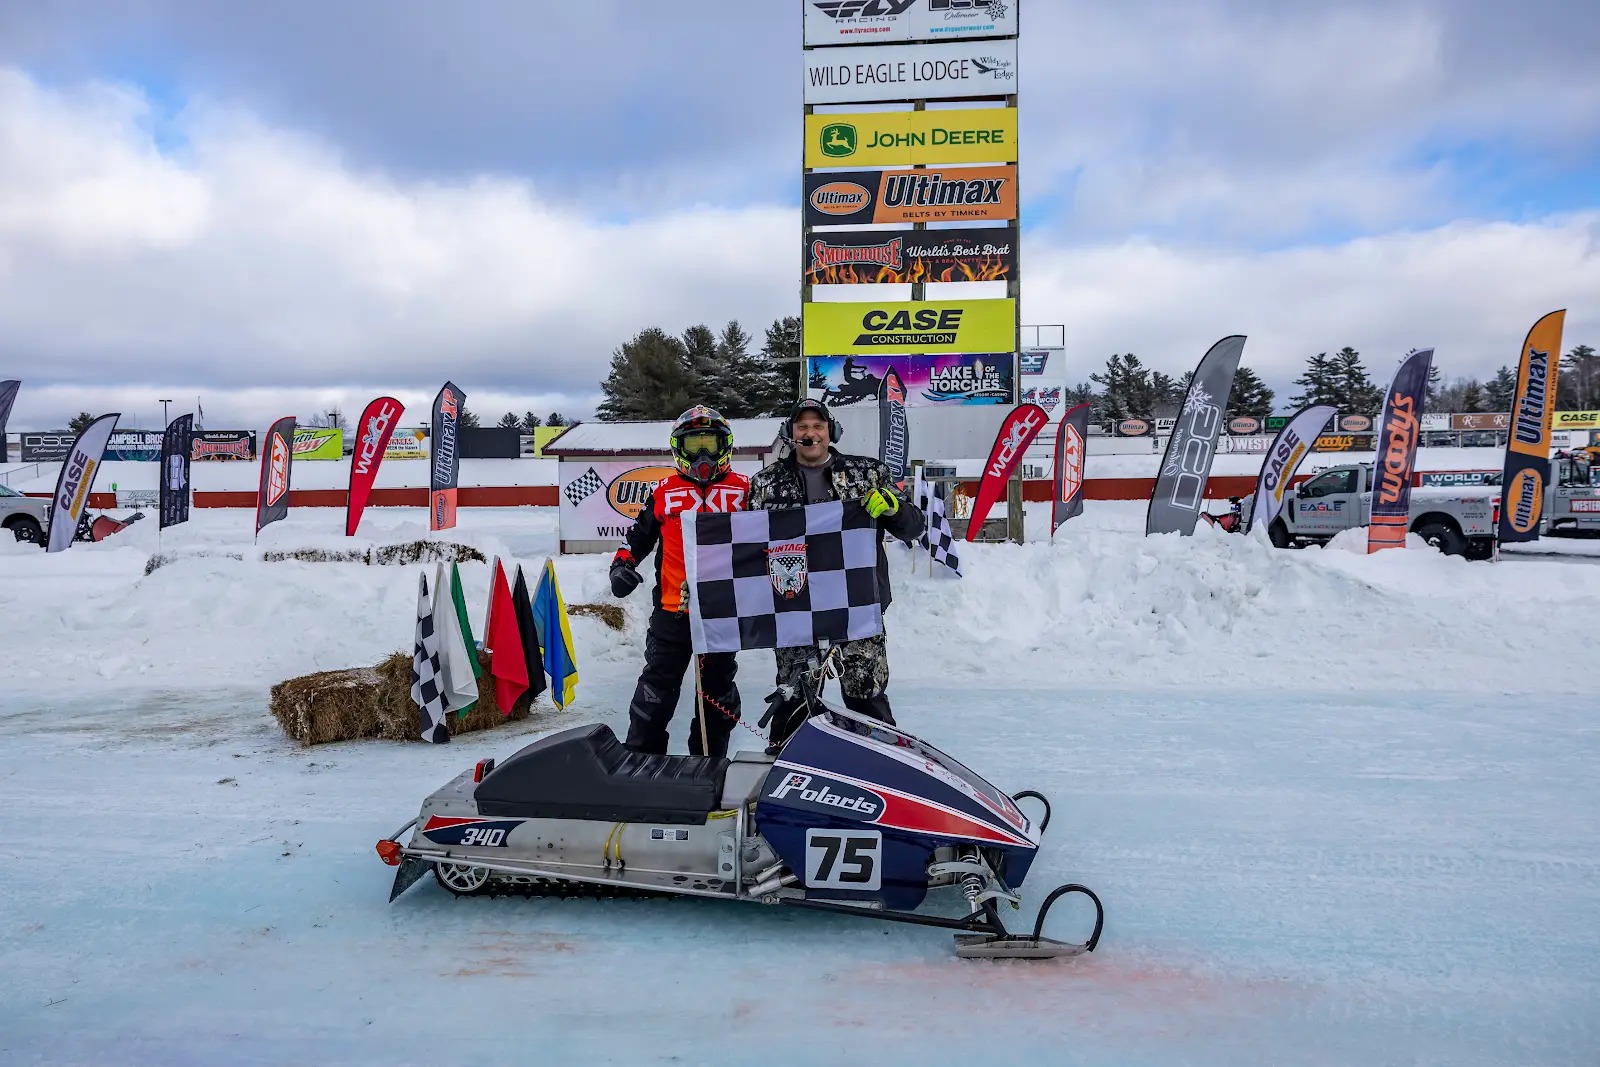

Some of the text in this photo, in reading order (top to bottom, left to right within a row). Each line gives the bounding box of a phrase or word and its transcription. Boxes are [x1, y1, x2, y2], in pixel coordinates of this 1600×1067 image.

[840, 26, 890, 34] www.flyracing.com
[810, 60, 969, 86] WILD EAGLE LODGE
[866, 129, 1004, 148] JOHN DEERE
[816, 191, 863, 204] Ultimax
[883, 174, 1006, 208] Ultimax
[813, 237, 902, 270] SMOKEHOUSE
[906, 244, 1010, 258] World's Best Brat
[862, 309, 964, 330] CASE
[871, 334, 953, 344] CONSTRUCTION
[930, 366, 972, 380] LAKE
[930, 379, 1000, 392] TORCHES
[1516, 346, 1549, 445] Ultimax
[1560, 413, 1598, 422] CASE
[192, 436, 250, 460] SMOKEHOUSE
[435, 412, 458, 484] Ultimax
[885, 400, 906, 478] Ultimax
[1264, 428, 1300, 490] CASE
[60, 450, 88, 510] CASE
[1430, 474, 1482, 482] WORLD
[664, 490, 745, 515] FXR
[1300, 502, 1342, 511] EAGLE
[1514, 473, 1536, 528] Ultimax
[765, 544, 808, 554] VINTAGE
[768, 772, 878, 815] Polaris
[460, 828, 506, 847] 340
[810, 836, 878, 883] 75
